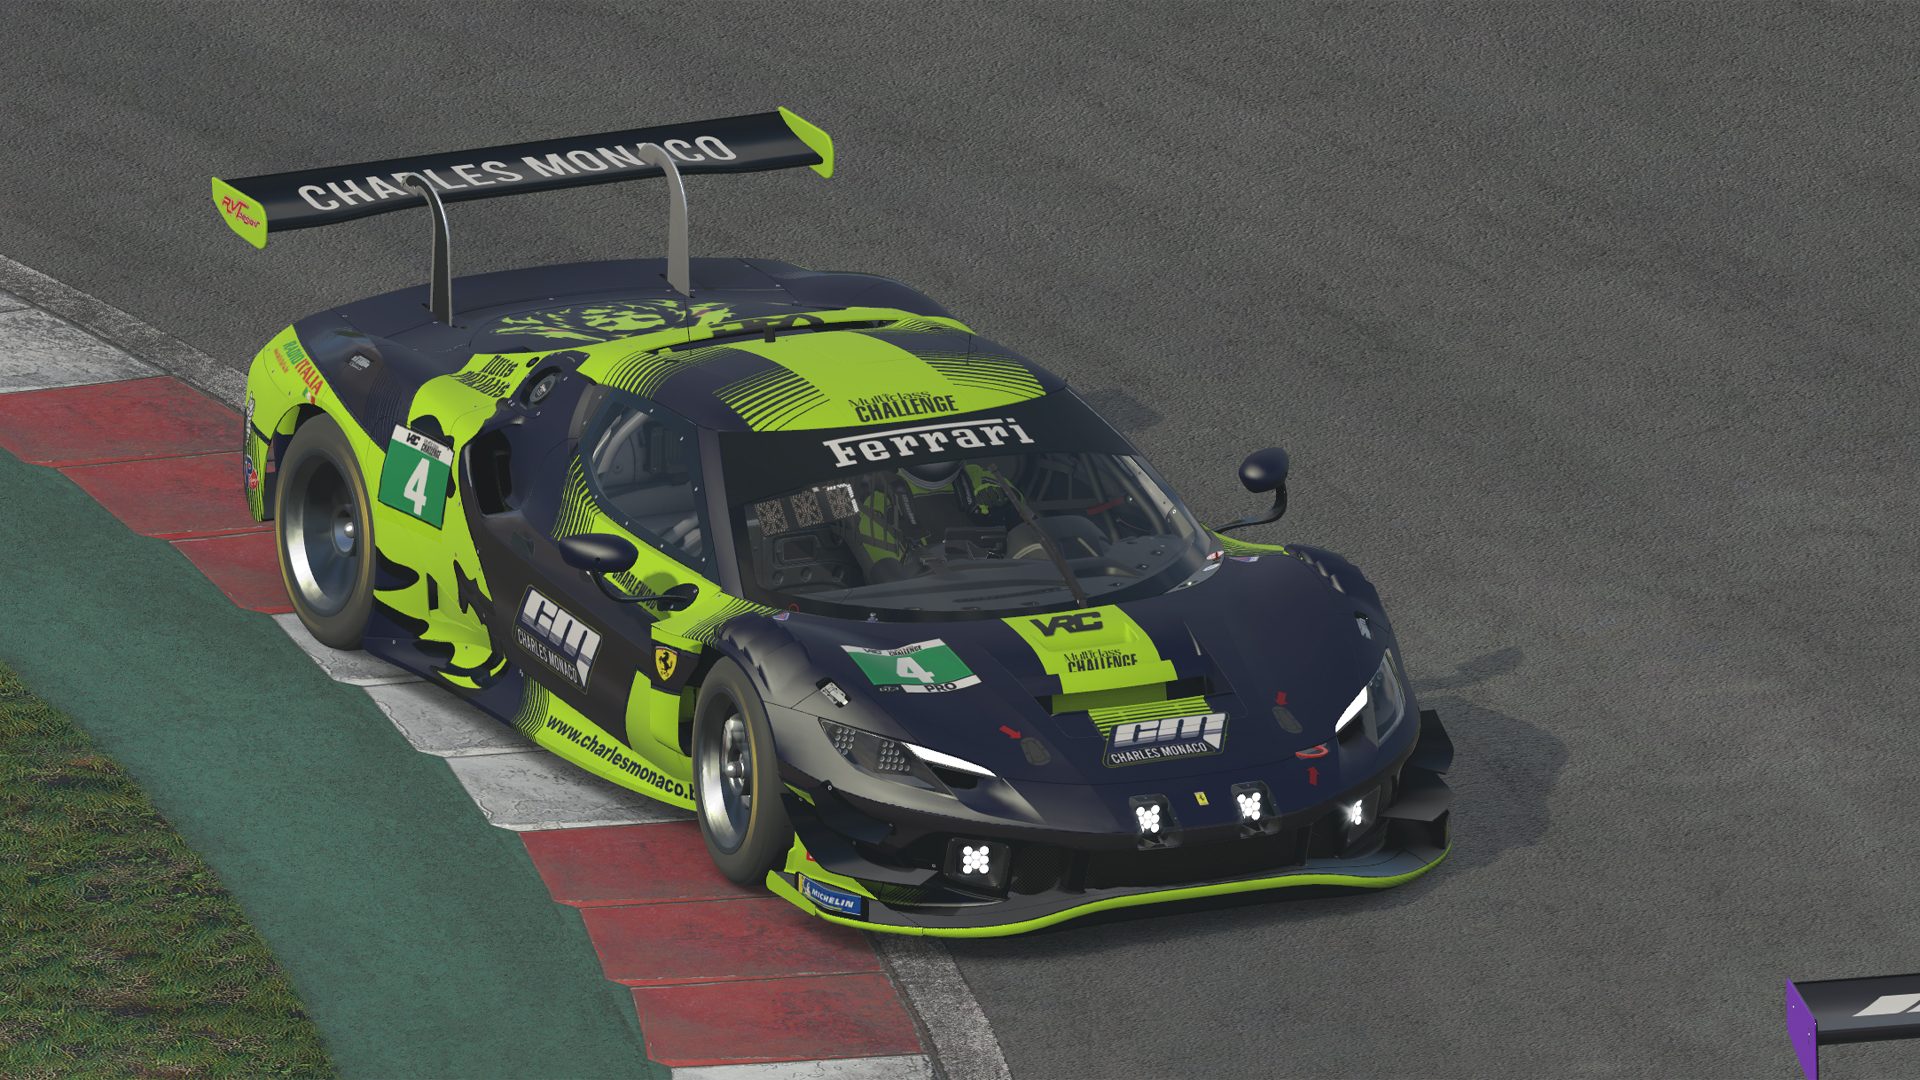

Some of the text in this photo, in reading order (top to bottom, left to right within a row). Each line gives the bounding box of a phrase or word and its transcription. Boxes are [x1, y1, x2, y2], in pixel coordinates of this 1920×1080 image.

[521, 135, 737, 177] MONCO
[854, 395, 959, 423] CHALLENGE
[822, 417, 1035, 468] Ferrari
[403, 457, 430, 516] 4
[1029, 611, 1104, 637] VRC
[517, 628, 578, 684] CHARLES MONACO
[896, 656, 935, 683] 4
[924, 682, 957, 693] PRO
[1110, 742, 1208, 764] CHARLES MONACO
[811, 889, 854, 909] MICHELIN
